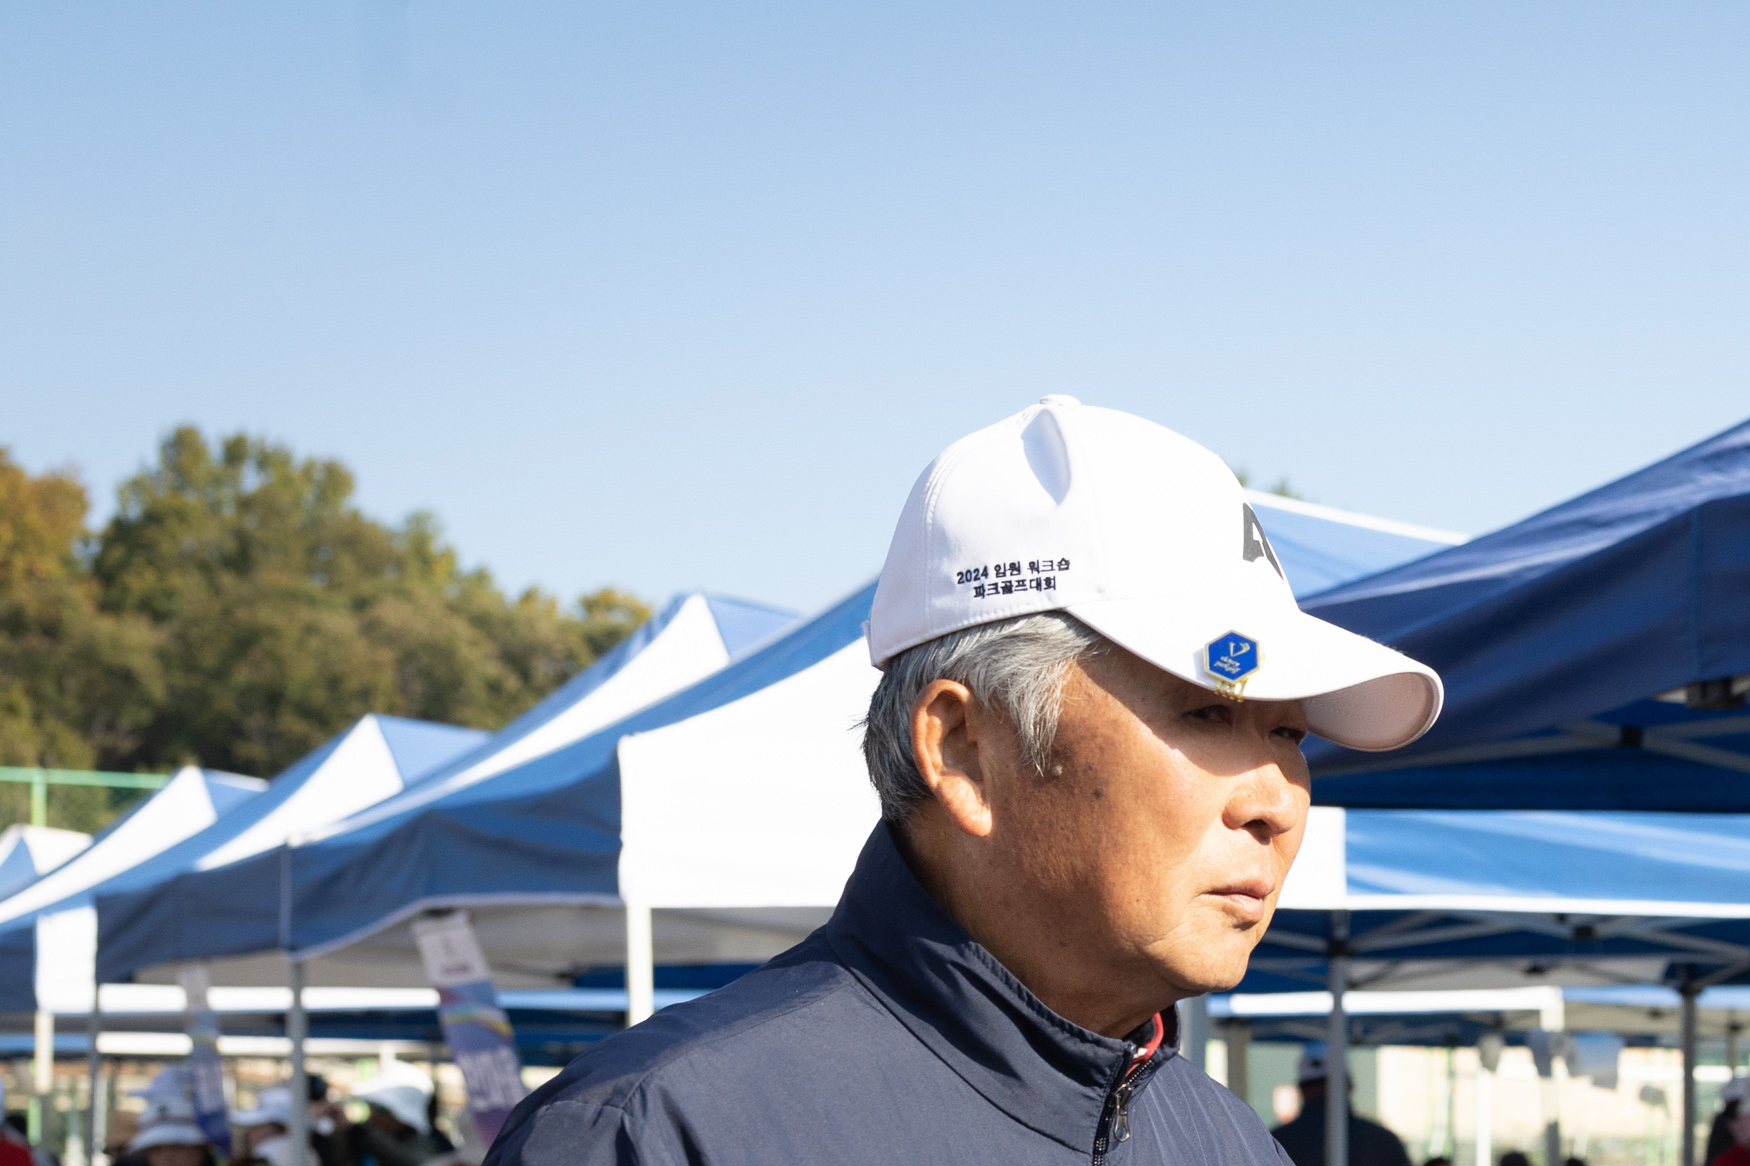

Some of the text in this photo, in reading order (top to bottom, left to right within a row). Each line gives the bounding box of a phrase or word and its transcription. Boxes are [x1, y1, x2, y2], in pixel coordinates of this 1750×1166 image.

[956, 557, 1070, 585] 2024 임원 워크숍
[973, 575, 1056, 598] 파크골프대회
